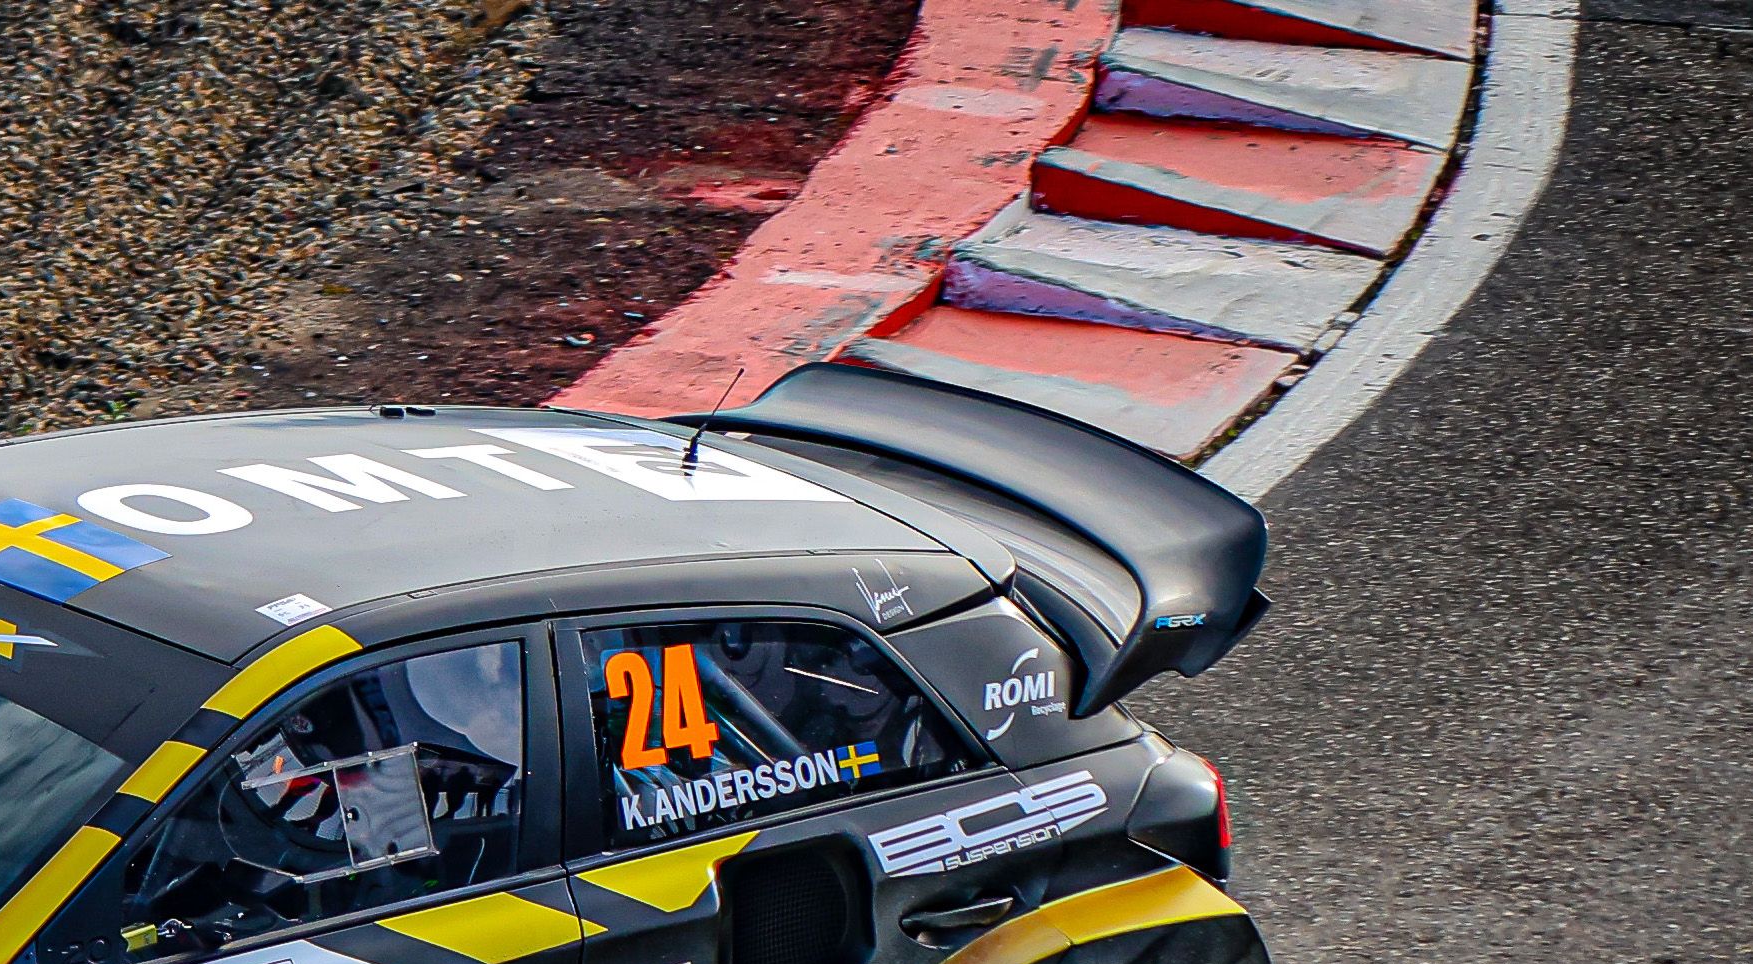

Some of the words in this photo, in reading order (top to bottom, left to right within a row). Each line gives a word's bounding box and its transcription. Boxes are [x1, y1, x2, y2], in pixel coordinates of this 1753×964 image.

[76, 443, 575, 536] OMT
[1155, 613, 1207, 629] PGRX
[604, 642, 720, 770] 24
[984, 670, 1055, 711] ROMI
[620, 749, 841, 832] K.ANDERSSON
